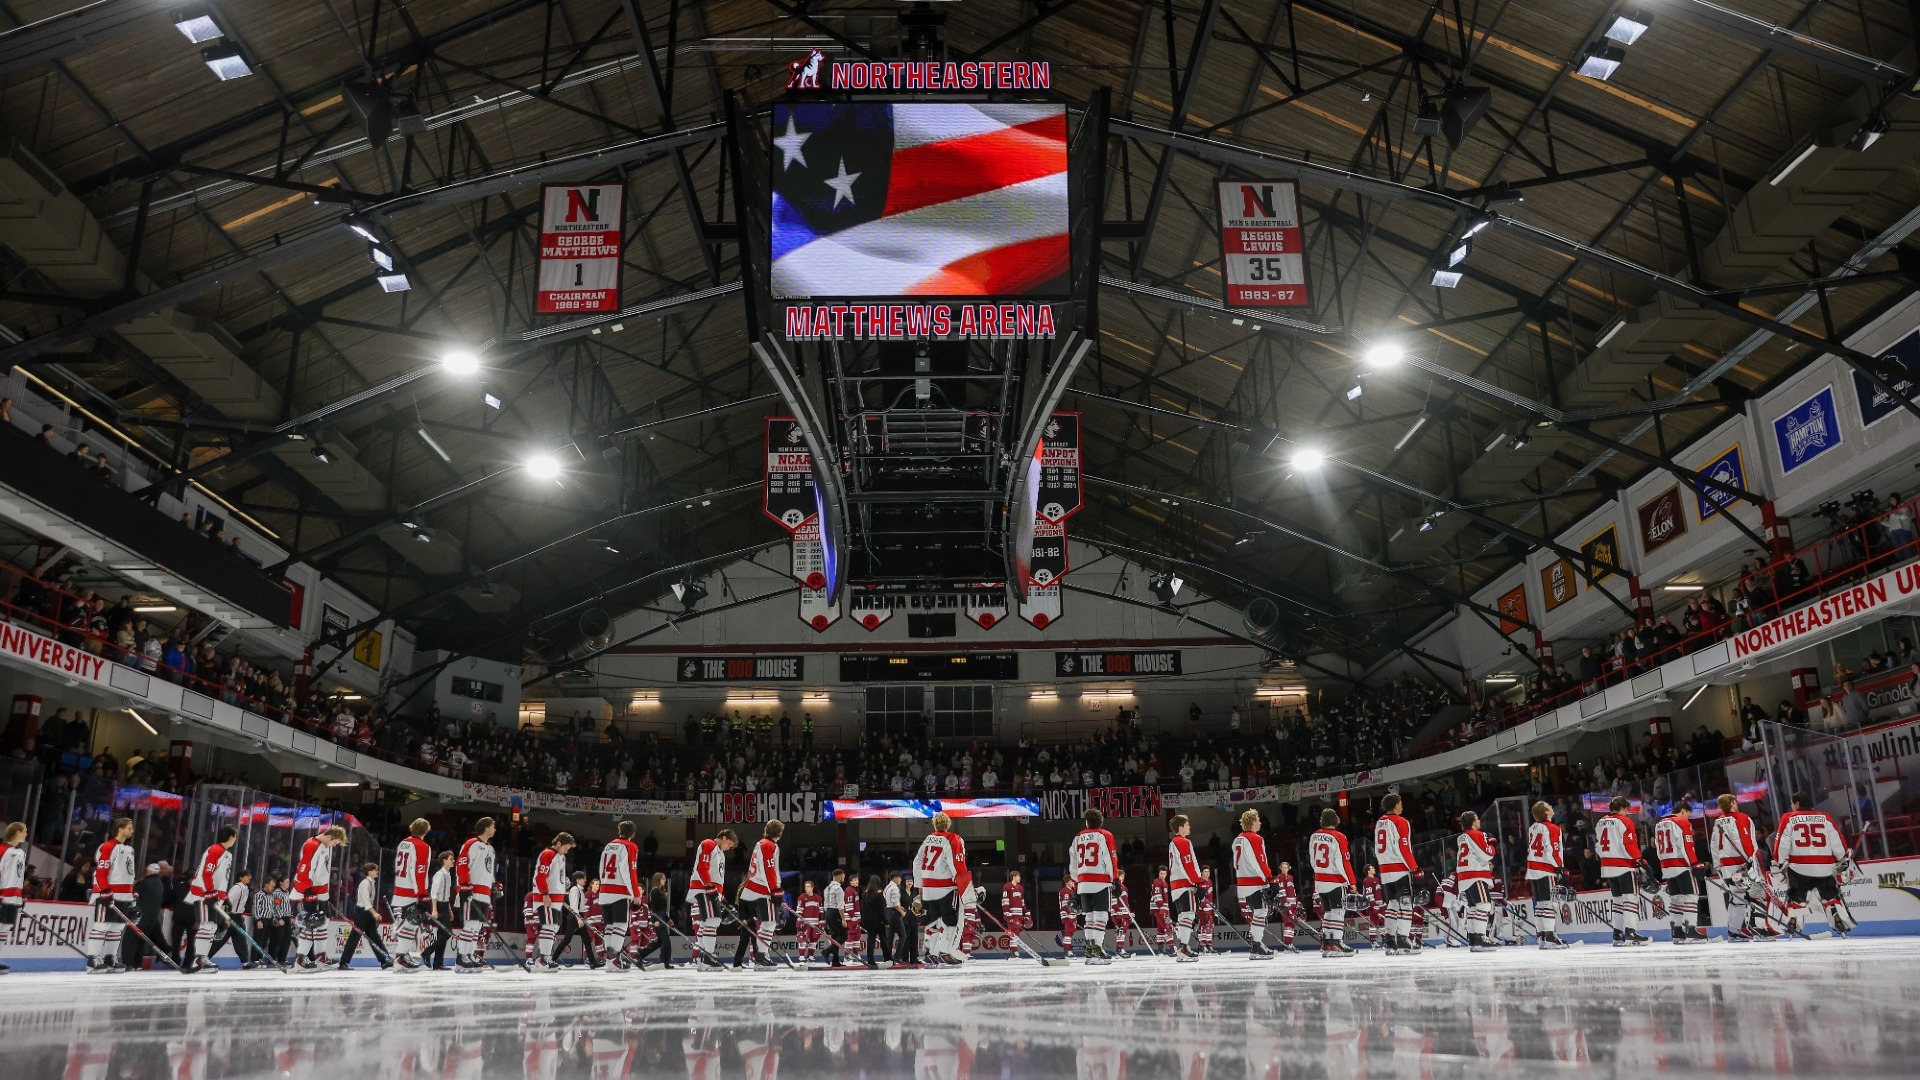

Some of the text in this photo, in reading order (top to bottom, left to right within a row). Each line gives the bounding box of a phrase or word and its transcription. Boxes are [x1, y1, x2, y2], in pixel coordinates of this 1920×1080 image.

[832, 62, 1050, 88] NORTHEASTERN
[565, 189, 600, 222] N
[1241, 185, 1276, 217] N
[558, 236, 604, 246] GEORGE
[1241, 231, 1283, 240] REGGIE
[1243, 242, 1283, 251] LEWIS
[543, 246, 618, 256] MATTHEWS
[575, 263, 583, 286] 1
[1249, 258, 1281, 280] 35
[549, 292, 606, 300] CHAIRMAN
[785, 305, 1056, 338] MATTHEWS ARENA
[1790, 417, 1824, 448] HAMPTON
[778, 455, 811, 464] NCAA
[1651, 518, 1674, 540] ELON
[1734, 578, 1887, 658] NORTHEASTERN
[0, 622, 104, 681] NIVERSITY
[703, 659, 797, 679] THE DOG HOUSE
[1080, 654, 1174, 673] THE DOG HOUSE
[1867, 683, 1909, 708] Grinold
[1043, 786, 1162, 820] NORTHEASTERN
[1377, 829, 1388, 854] 9
[1402, 837, 1408, 846] 9
[1599, 828, 1610, 852] 4
[1793, 824, 1826, 847] 35
[98, 860, 110, 869] 26
[395, 851, 409, 878] 21
[458, 857, 468, 866] 92
[602, 853, 617, 880] 14
[766, 859, 775, 868] 15
[922, 846, 943, 871] 47
[954, 854, 965, 862] 47
[1077, 842, 1099, 868] 33
[1313, 843, 1330, 868] 13
[417, 865, 426, 873] 21
[540, 864, 550, 875] 93
